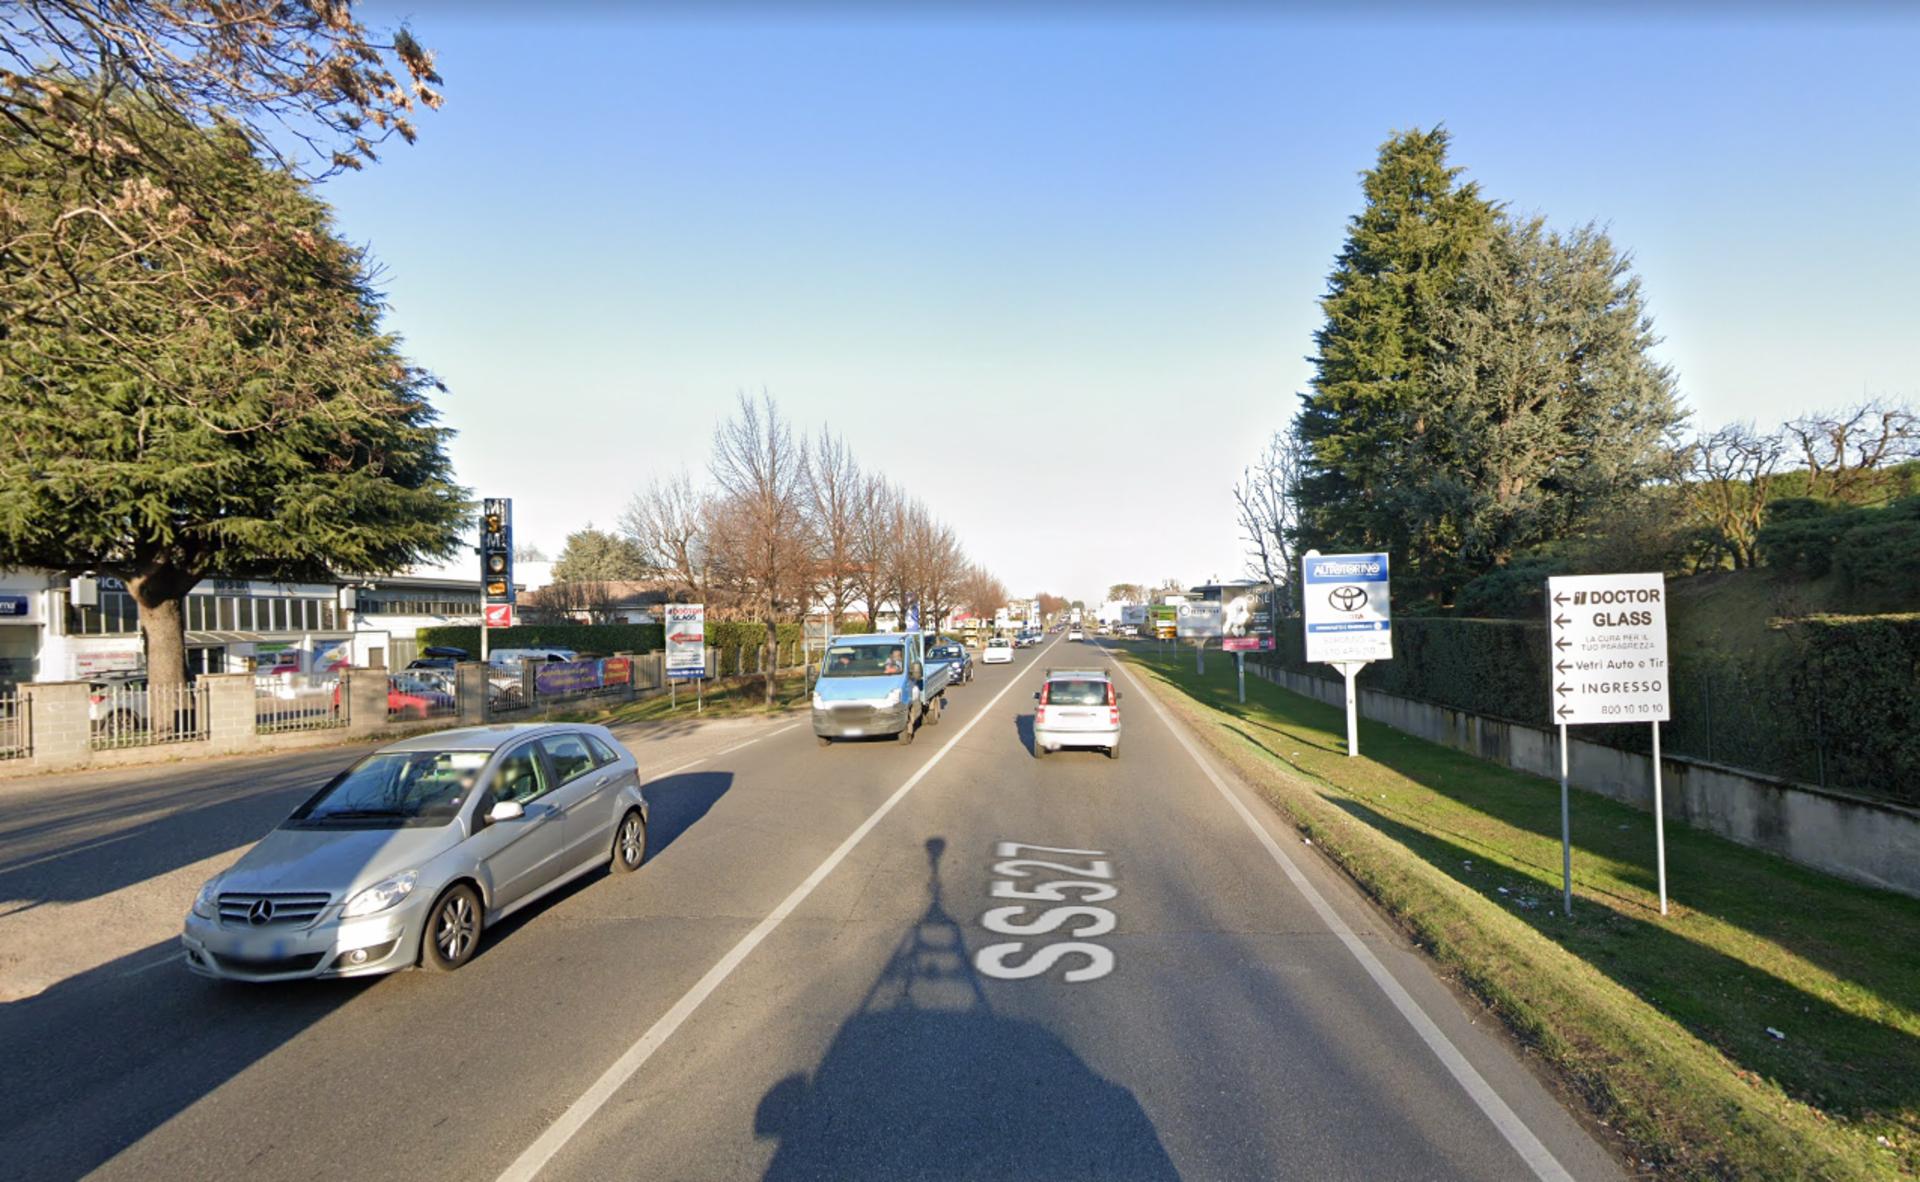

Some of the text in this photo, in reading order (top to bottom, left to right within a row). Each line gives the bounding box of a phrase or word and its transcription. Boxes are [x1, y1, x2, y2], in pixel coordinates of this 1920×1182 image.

[1590, 588, 1661, 604] DOCTOR
[1593, 611, 1653, 627] GLASS
[1576, 657, 1665, 671] Vetri Auto e Tir
[1582, 680, 1662, 694] INGRESSO
[1601, 703, 1664, 715] 800 10 10 10
